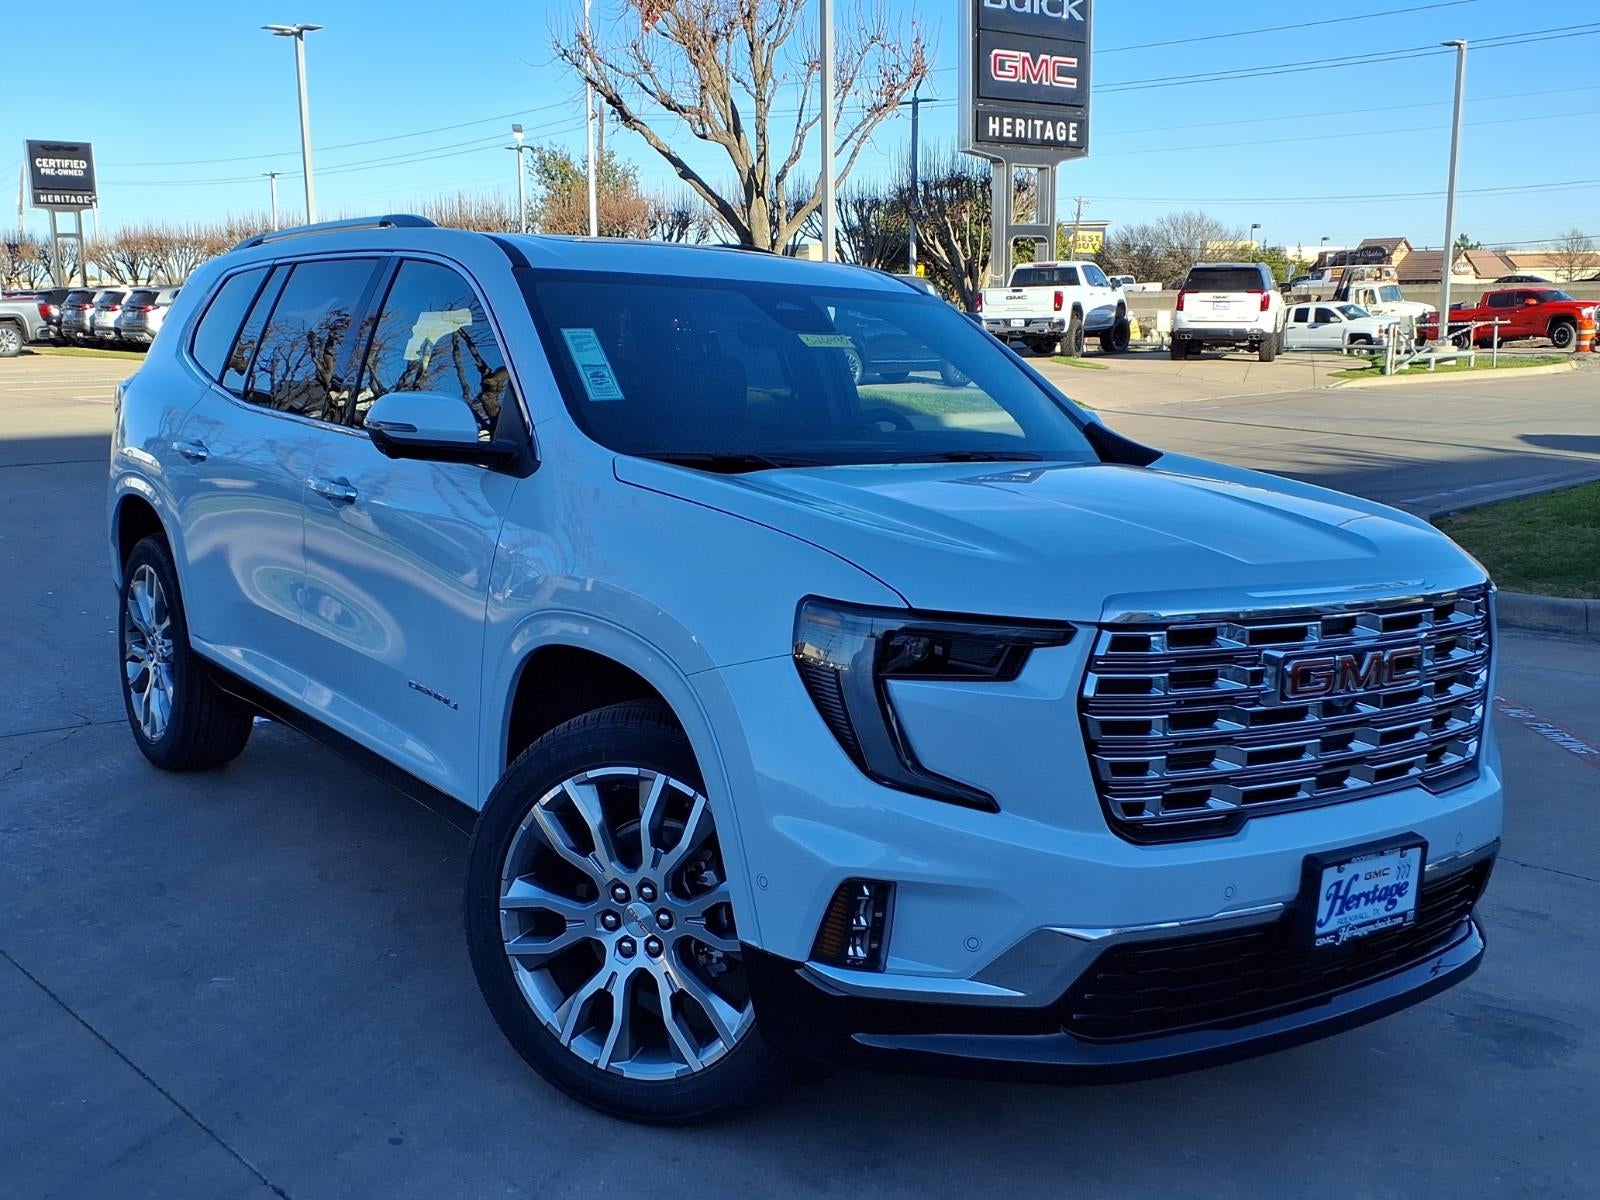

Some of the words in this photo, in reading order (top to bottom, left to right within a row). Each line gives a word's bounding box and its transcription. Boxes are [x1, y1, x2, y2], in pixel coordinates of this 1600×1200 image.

[991, 49, 1078, 89] GMC
[988, 116, 1078, 142] HERITAGE
[35, 157, 87, 169] CERTIFIED
[40, 167, 84, 176] PRE-OWNED
[40, 194, 91, 204] HERITAGE
[1284, 646, 1422, 698] GMC
[1363, 867, 1391, 881] GMC
[1316, 873, 1410, 929] Heritage
